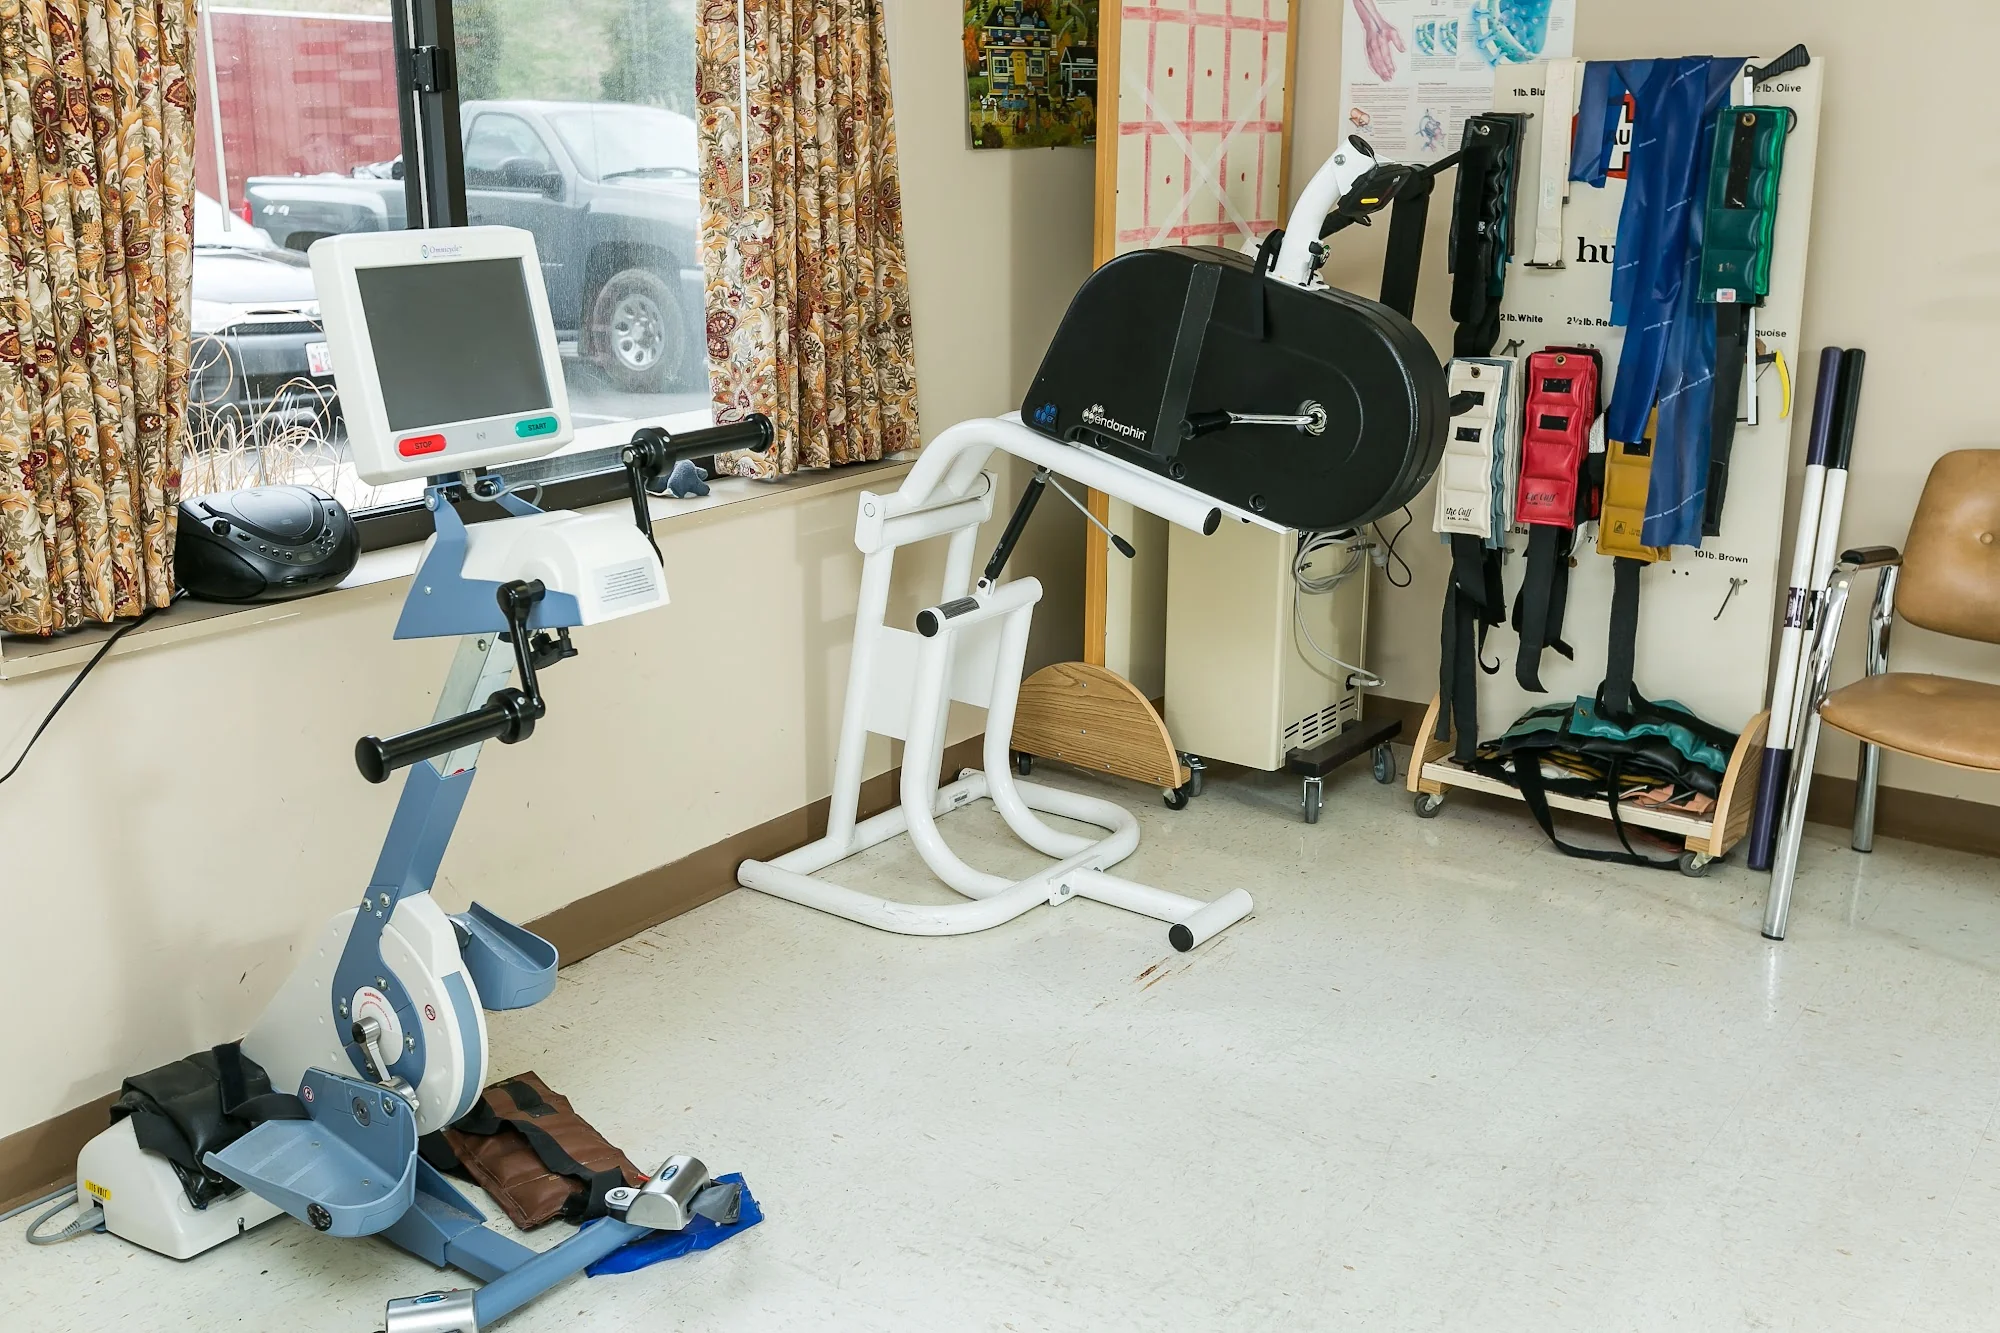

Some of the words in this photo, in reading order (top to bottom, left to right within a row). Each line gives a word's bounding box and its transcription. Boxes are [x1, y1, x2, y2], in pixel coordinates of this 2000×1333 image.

[1530, 87, 1546, 96] Blu
[1777, 83, 1802, 93] Olive
[1576, 236, 1616, 264] hu
[1518, 314, 1543, 324] White
[1755, 329, 1787, 338] quoise
[527, 422, 547, 432] START
[1094, 414, 1146, 441] endorphin
[414, 441, 433, 450] STOP
[1446, 507, 1457, 516] the
[1458, 507, 1473, 518] Cuff
[1515, 526, 1528, 535] Bla
[1718, 552, 1748, 564] Brown
